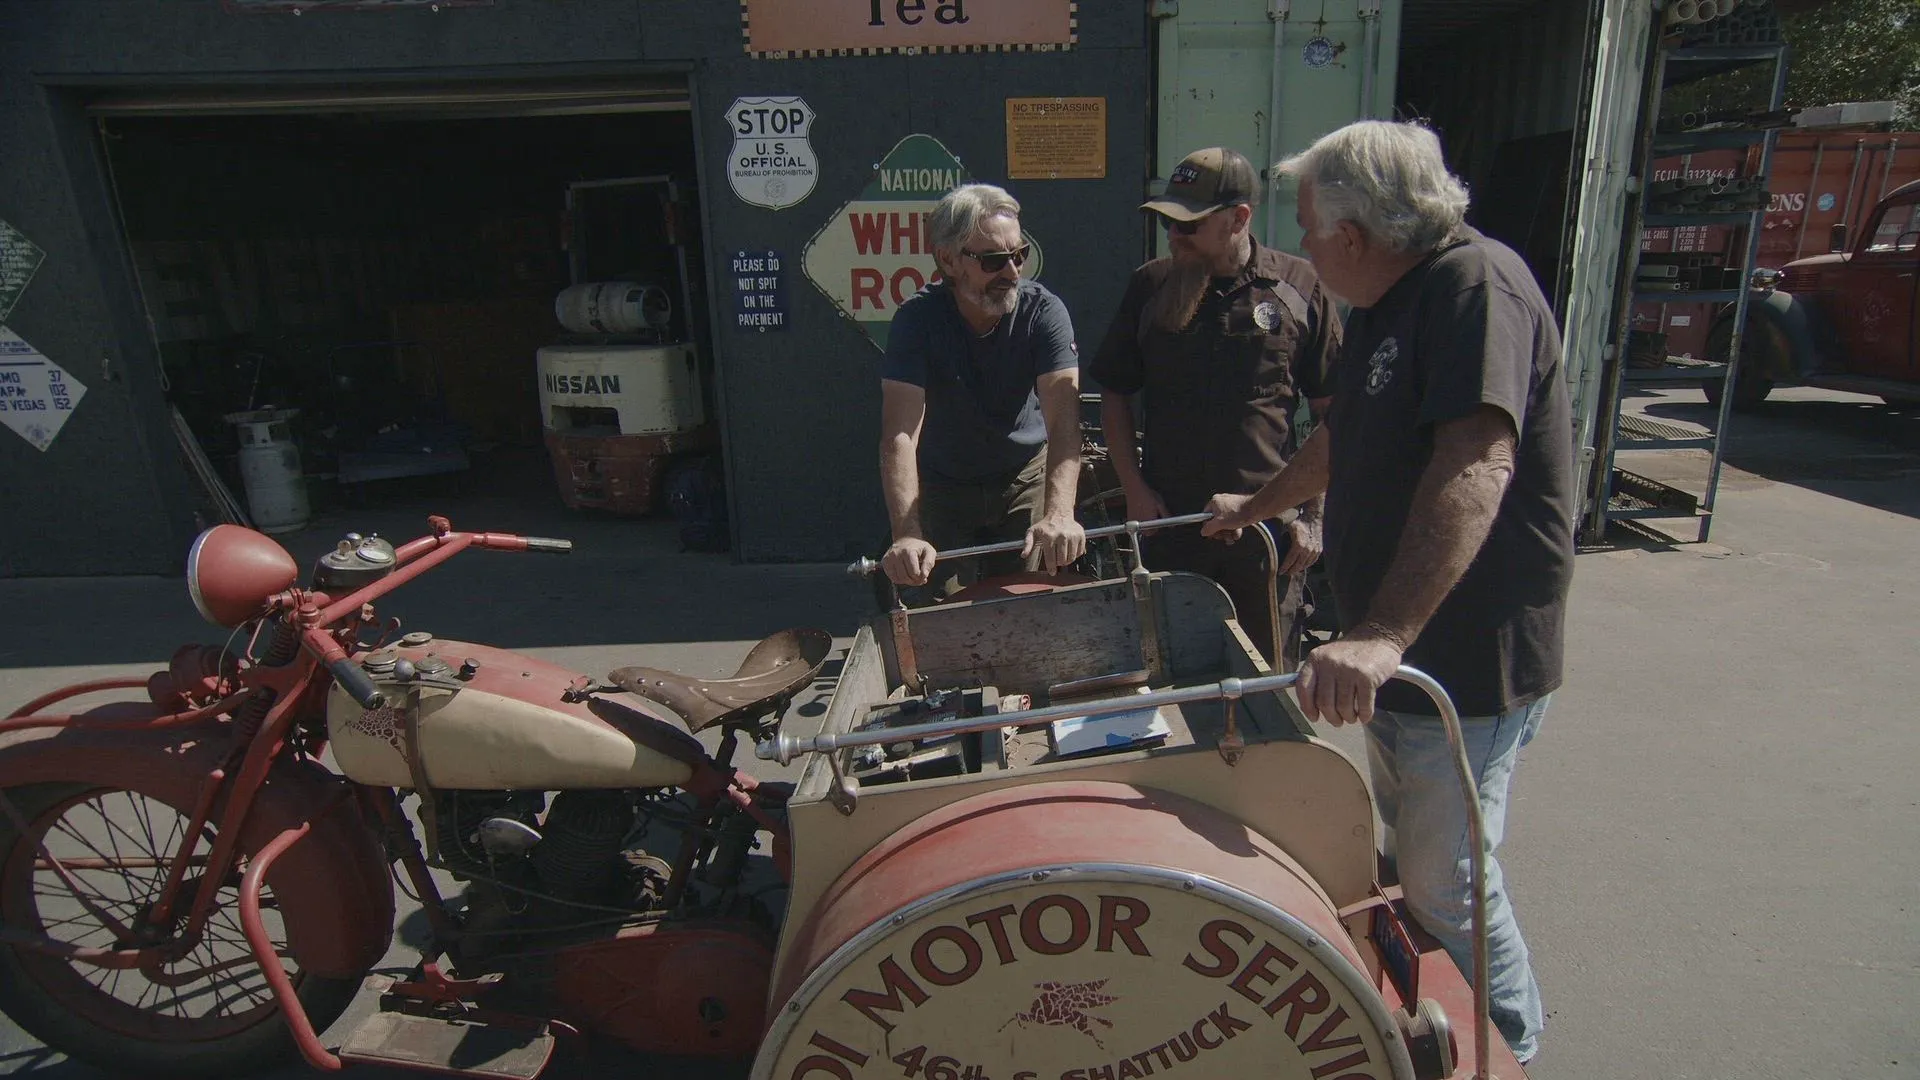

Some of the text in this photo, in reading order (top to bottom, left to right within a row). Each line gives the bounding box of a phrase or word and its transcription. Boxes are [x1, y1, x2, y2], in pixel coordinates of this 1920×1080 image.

[1013, 103, 1100, 112] NO TRESPASSING
[737, 108, 804, 135] STOP
[740, 157, 806, 168] OFFICIAL
[1765, 193, 1805, 212] ENS
[849, 212, 933, 255] WHI
[733, 258, 780, 272] PLEASE DO
[738, 277, 777, 290] NOT SPIT
[851, 267, 943, 310] RO
[743, 295, 775, 308] ON THE
[738, 312, 783, 326] PAVEMENT
[0, 370, 61, 384] MO 37
[546, 373, 621, 394] NISSAN
[48, 384, 68, 397] 102
[10, 399, 46, 411] VEGAS
[53, 397, 72, 410] 152
[840, 894, 1152, 1033] MOTOR
[1182, 920, 1376, 1080] SERVI
